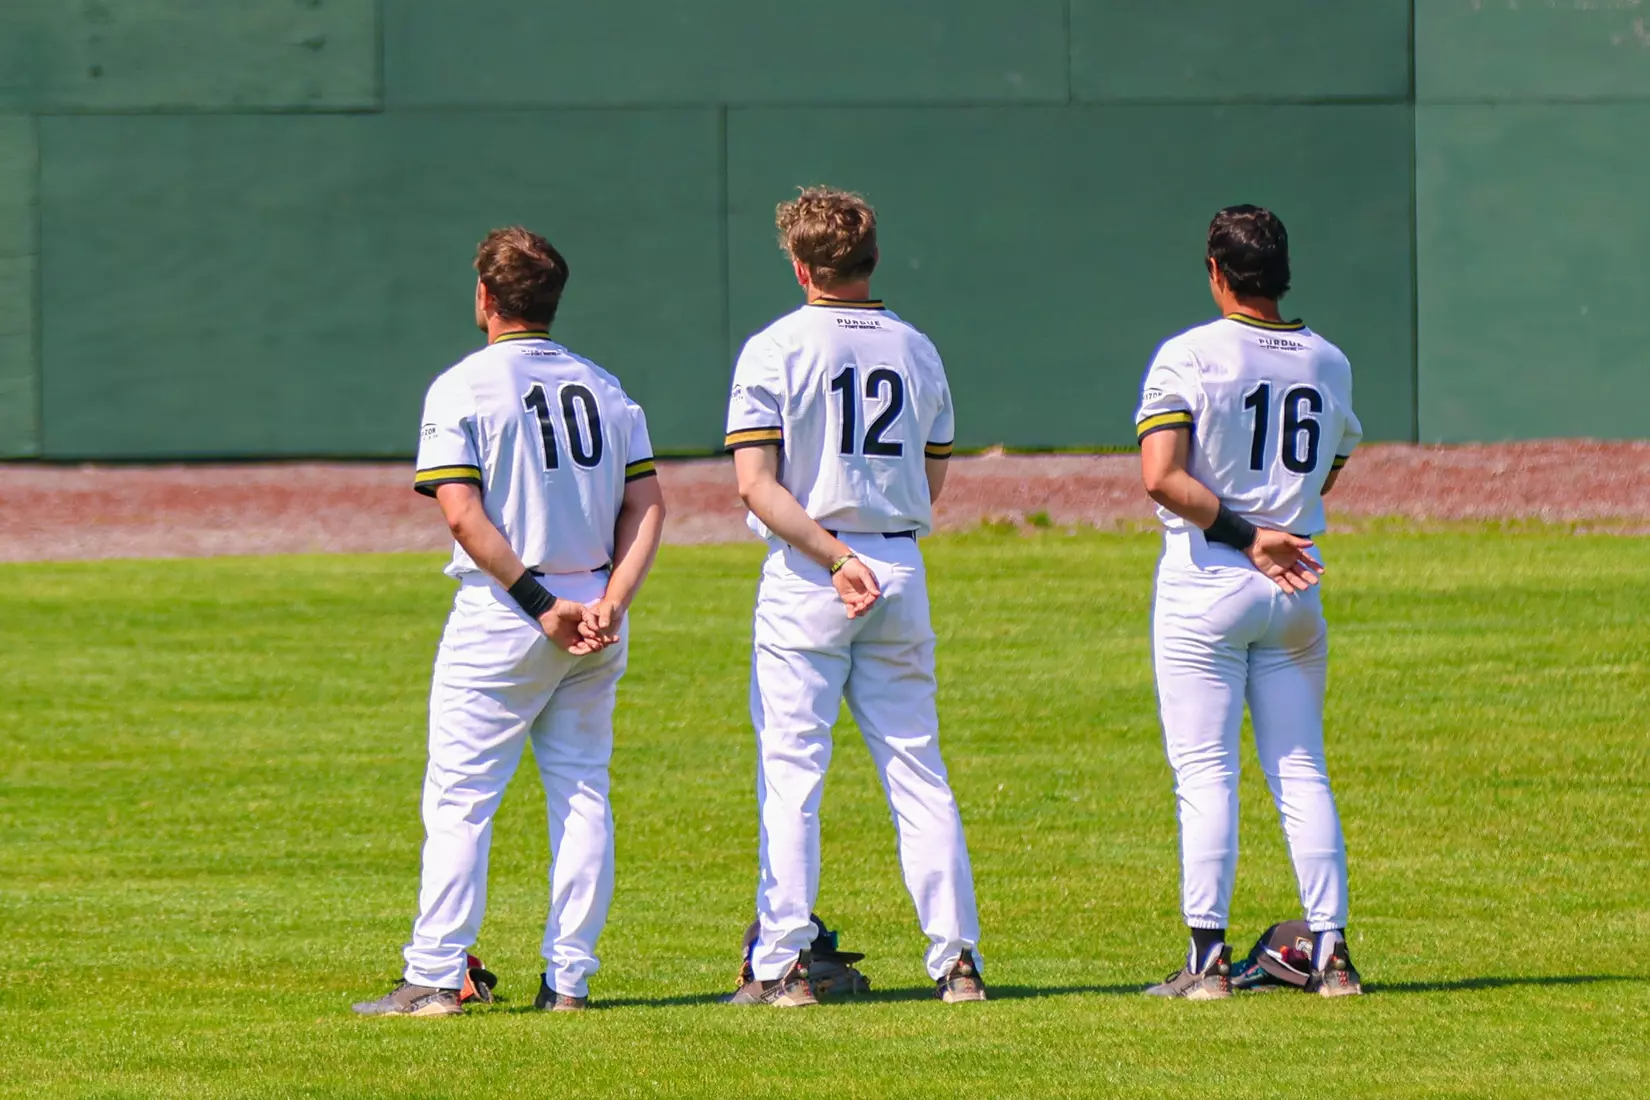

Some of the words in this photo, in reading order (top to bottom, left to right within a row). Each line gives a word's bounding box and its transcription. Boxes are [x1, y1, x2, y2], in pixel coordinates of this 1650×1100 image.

[836, 318, 881, 326] PURDUE
[524, 384, 603, 470] 10
[831, 366, 904, 458] 12
[1244, 383, 1323, 474] 16
